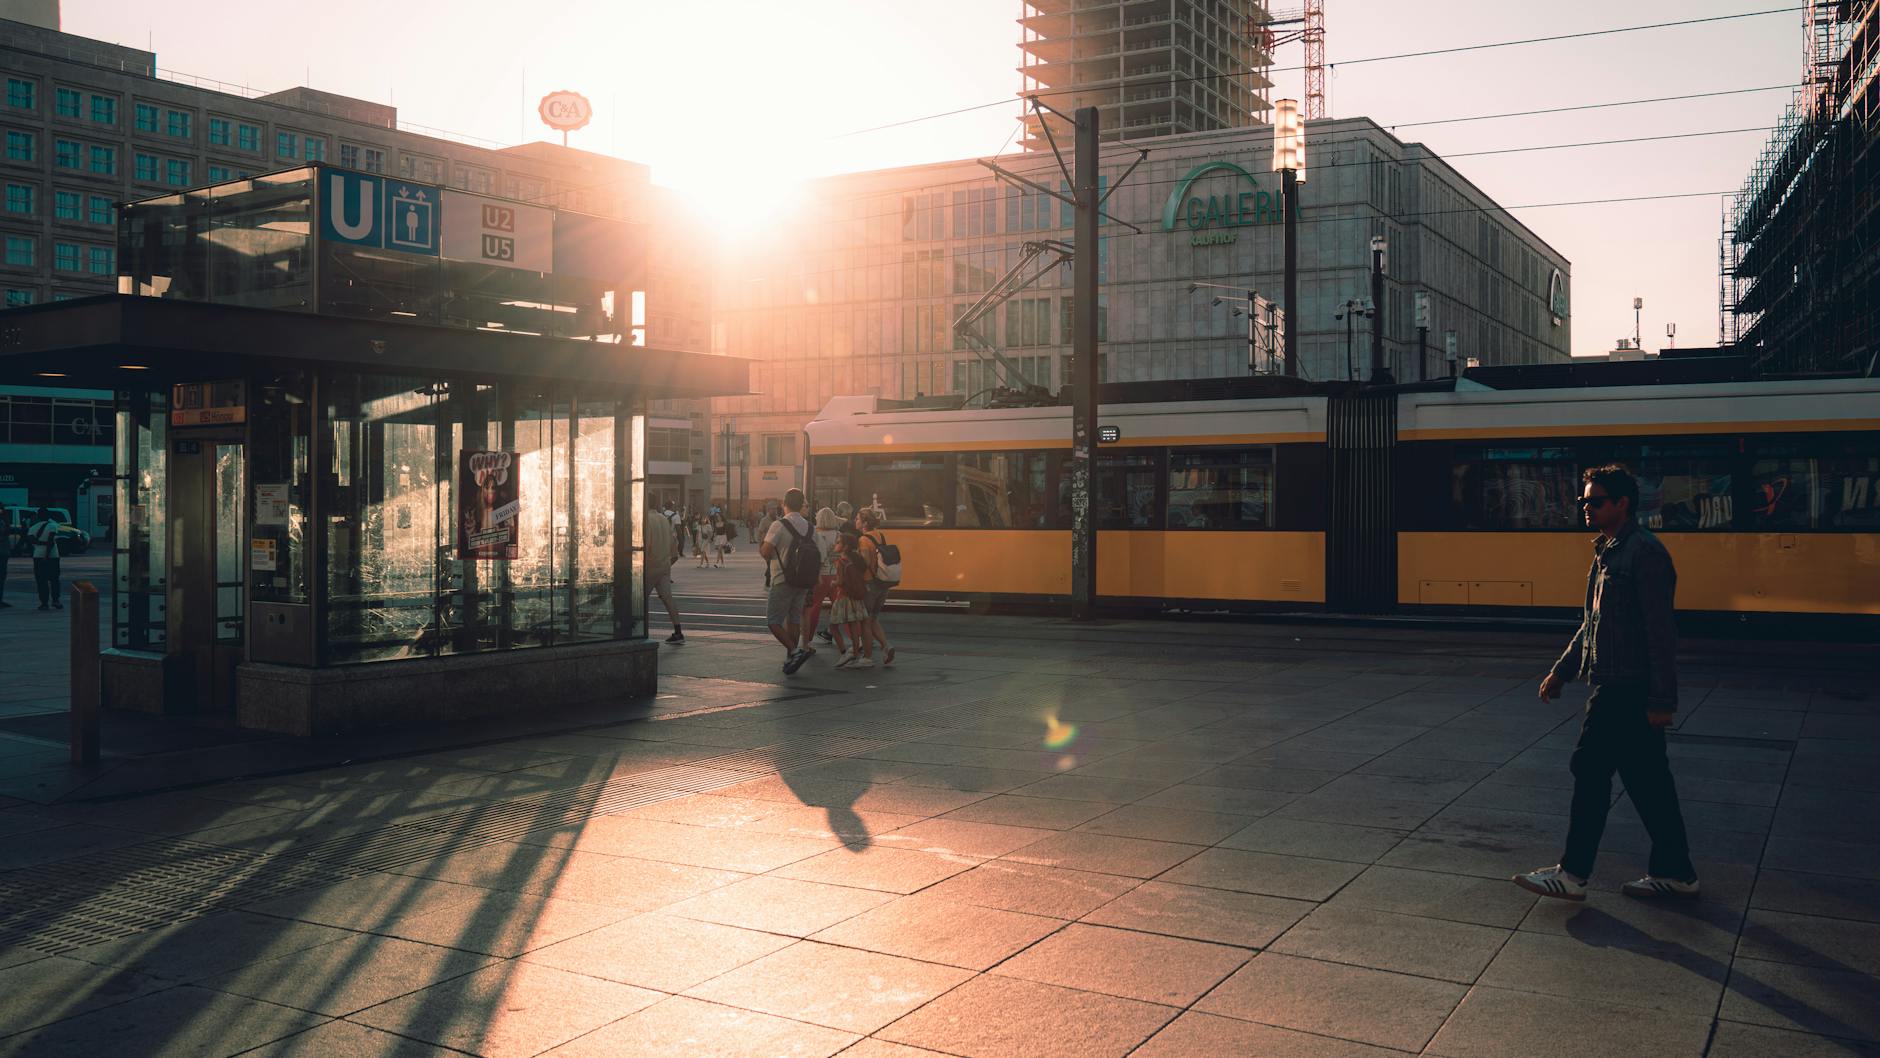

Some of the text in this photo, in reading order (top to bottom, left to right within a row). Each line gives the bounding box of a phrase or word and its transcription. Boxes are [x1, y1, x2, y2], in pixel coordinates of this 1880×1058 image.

[549, 101, 583, 118] C&A
[331, 175, 373, 240] U
[486, 204, 512, 230] U2
[1187, 189, 1302, 229] GALERI
[486, 234, 512, 259] U5
[1190, 232, 1239, 247] KAUFHOF
[472, 453, 508, 470] WHY?
